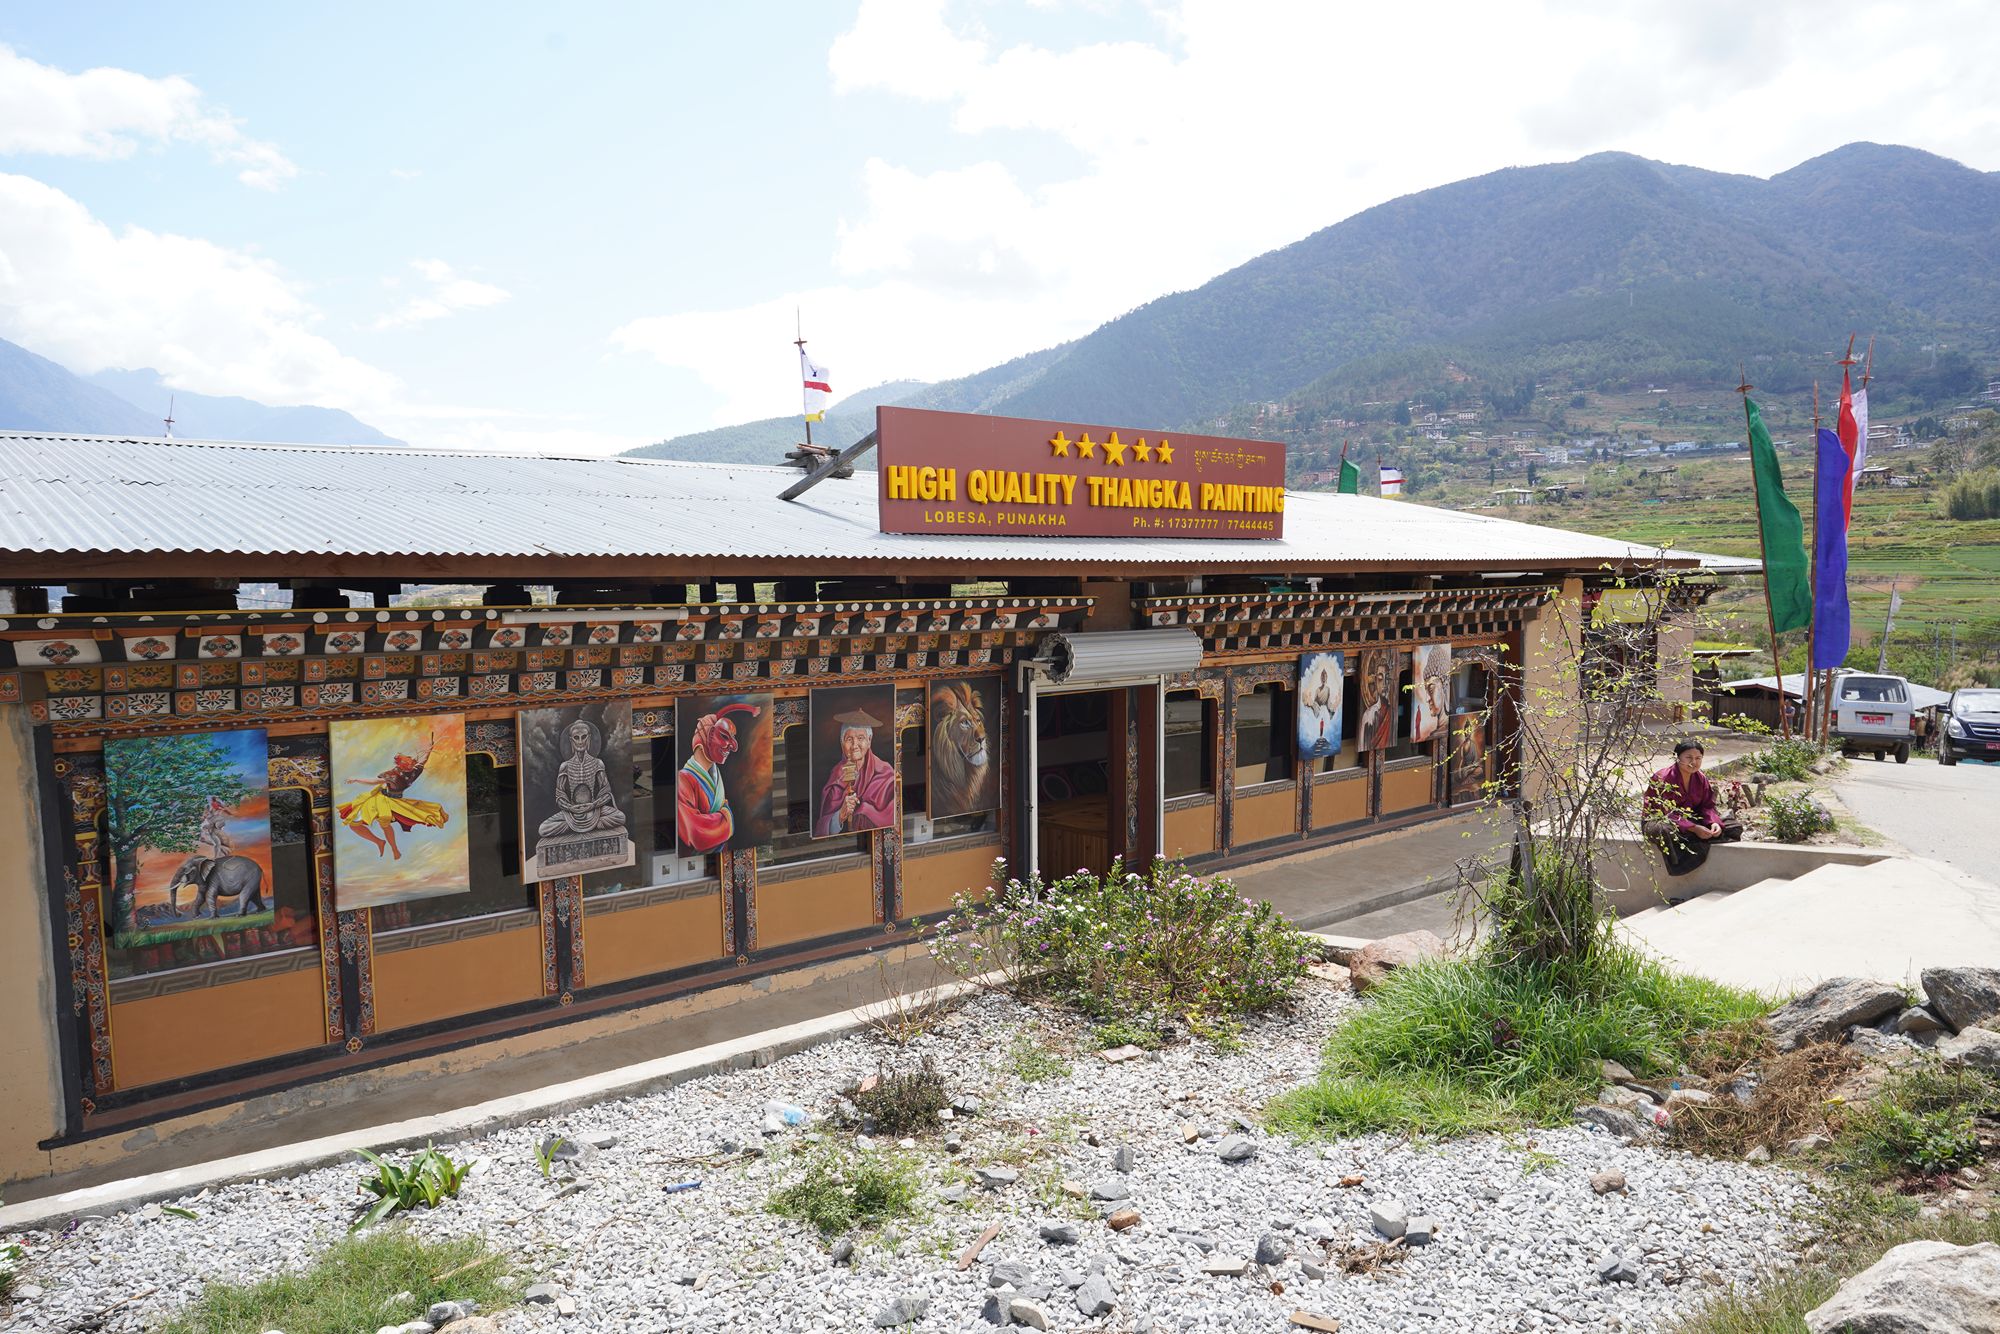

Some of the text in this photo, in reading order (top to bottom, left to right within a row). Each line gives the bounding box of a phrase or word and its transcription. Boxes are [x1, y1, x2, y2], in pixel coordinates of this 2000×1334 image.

[887, 465, 1285, 513] HIGH QUALITY THANGKA PAINTING
[925, 511, 1067, 527] LOBESA, PUNAKHA
[1133, 516, 1151, 528] Ph.
[1154, 517, 1165, 528] #:
[1168, 518, 1219, 529] 17377777
[1227, 519, 1275, 531] 77444445
